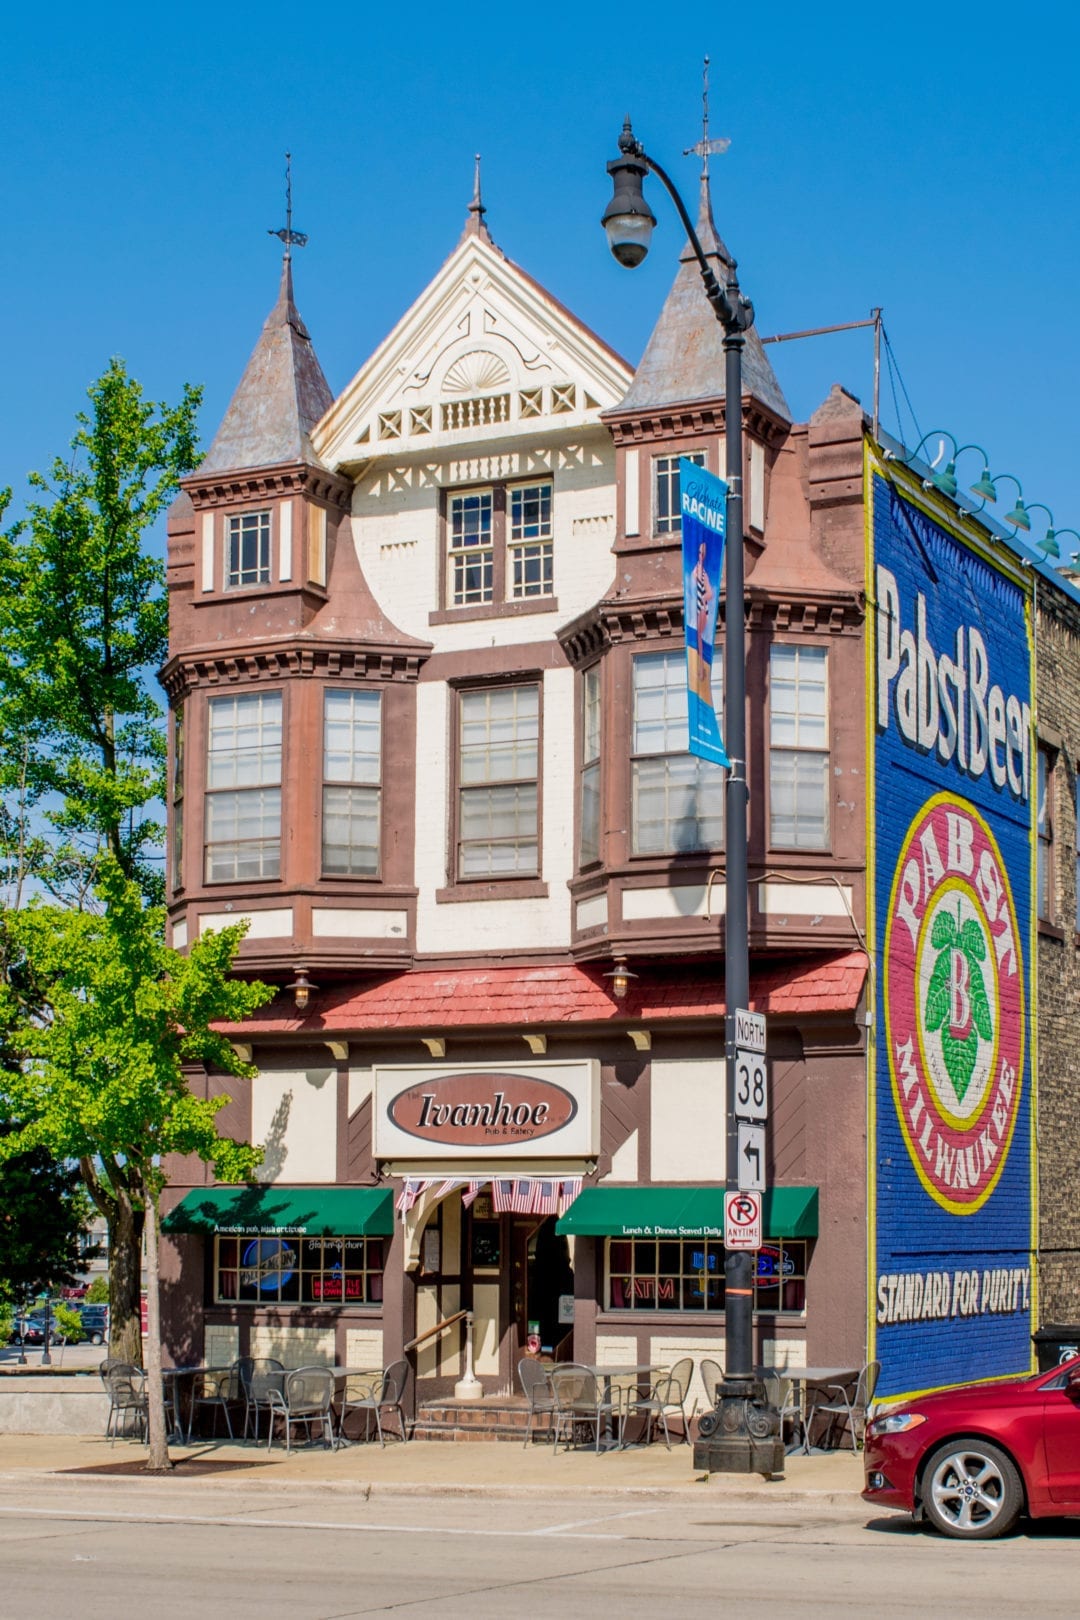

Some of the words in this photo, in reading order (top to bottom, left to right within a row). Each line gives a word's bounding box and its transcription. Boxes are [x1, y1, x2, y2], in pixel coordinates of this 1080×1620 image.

[682, 493, 724, 532] RACINE
[876, 563, 968, 771] Pabst
[968, 625, 1031, 801] Beer
[897, 811, 1017, 977] PABST
[949, 948, 972, 1034] B
[737, 1016, 765, 1045] NORTH
[738, 1065, 764, 1107] 38
[416, 1092, 549, 1127] Ivanhoe
[896, 1031, 1015, 1189] MILWAUKEE
[511, 1128, 535, 1136] Eatery
[622, 1225, 643, 1234] Lunch
[727, 1227, 759, 1238] ANYTIME
[625, 1277, 674, 1299] ATM
[877, 1271, 950, 1323] STANDARD
[951, 1270, 979, 1316] FOR
